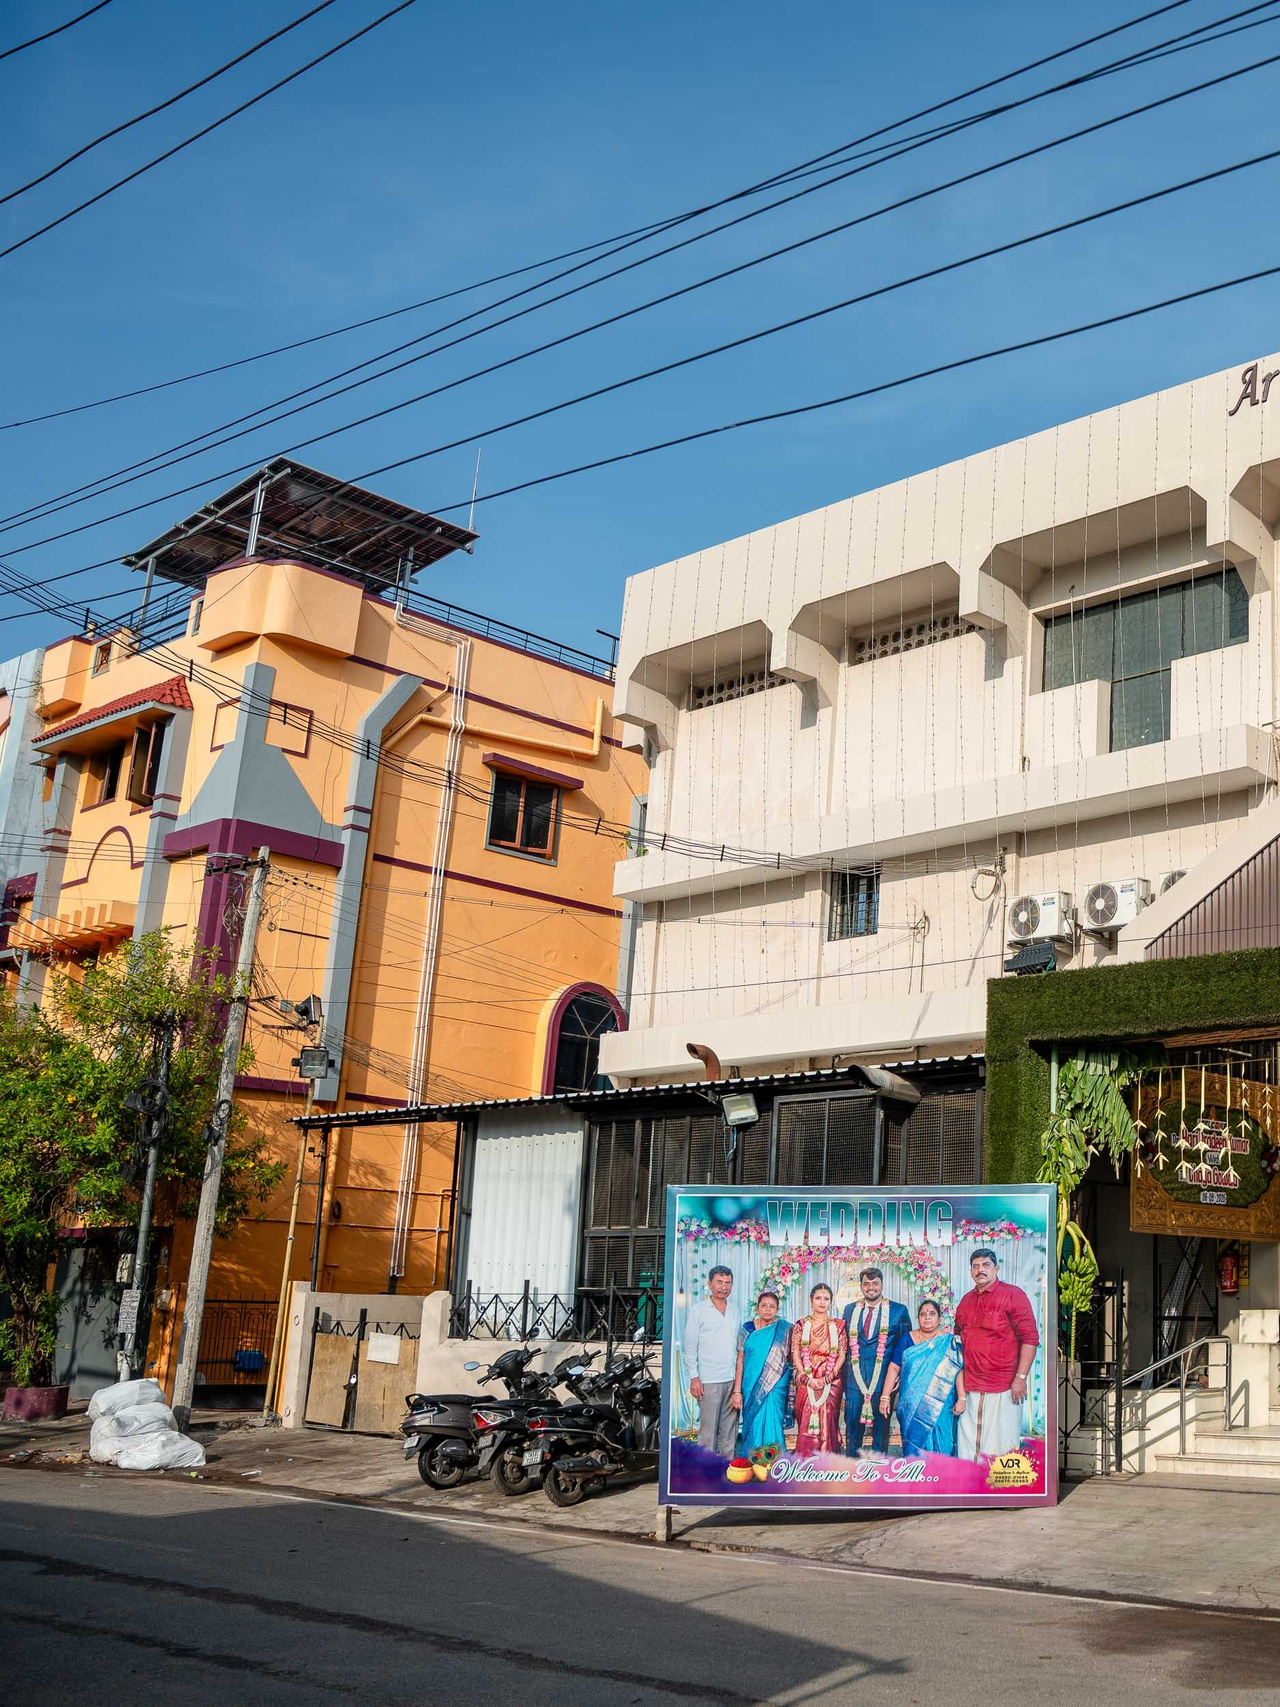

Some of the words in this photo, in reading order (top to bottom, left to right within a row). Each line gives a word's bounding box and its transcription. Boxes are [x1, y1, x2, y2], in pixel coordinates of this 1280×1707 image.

[766, 1200, 953, 1246] WEDDING
[770, 1456, 849, 1484] Welcome
[852, 1457, 889, 1483] To
[999, 1458, 1021, 1468] VDR
